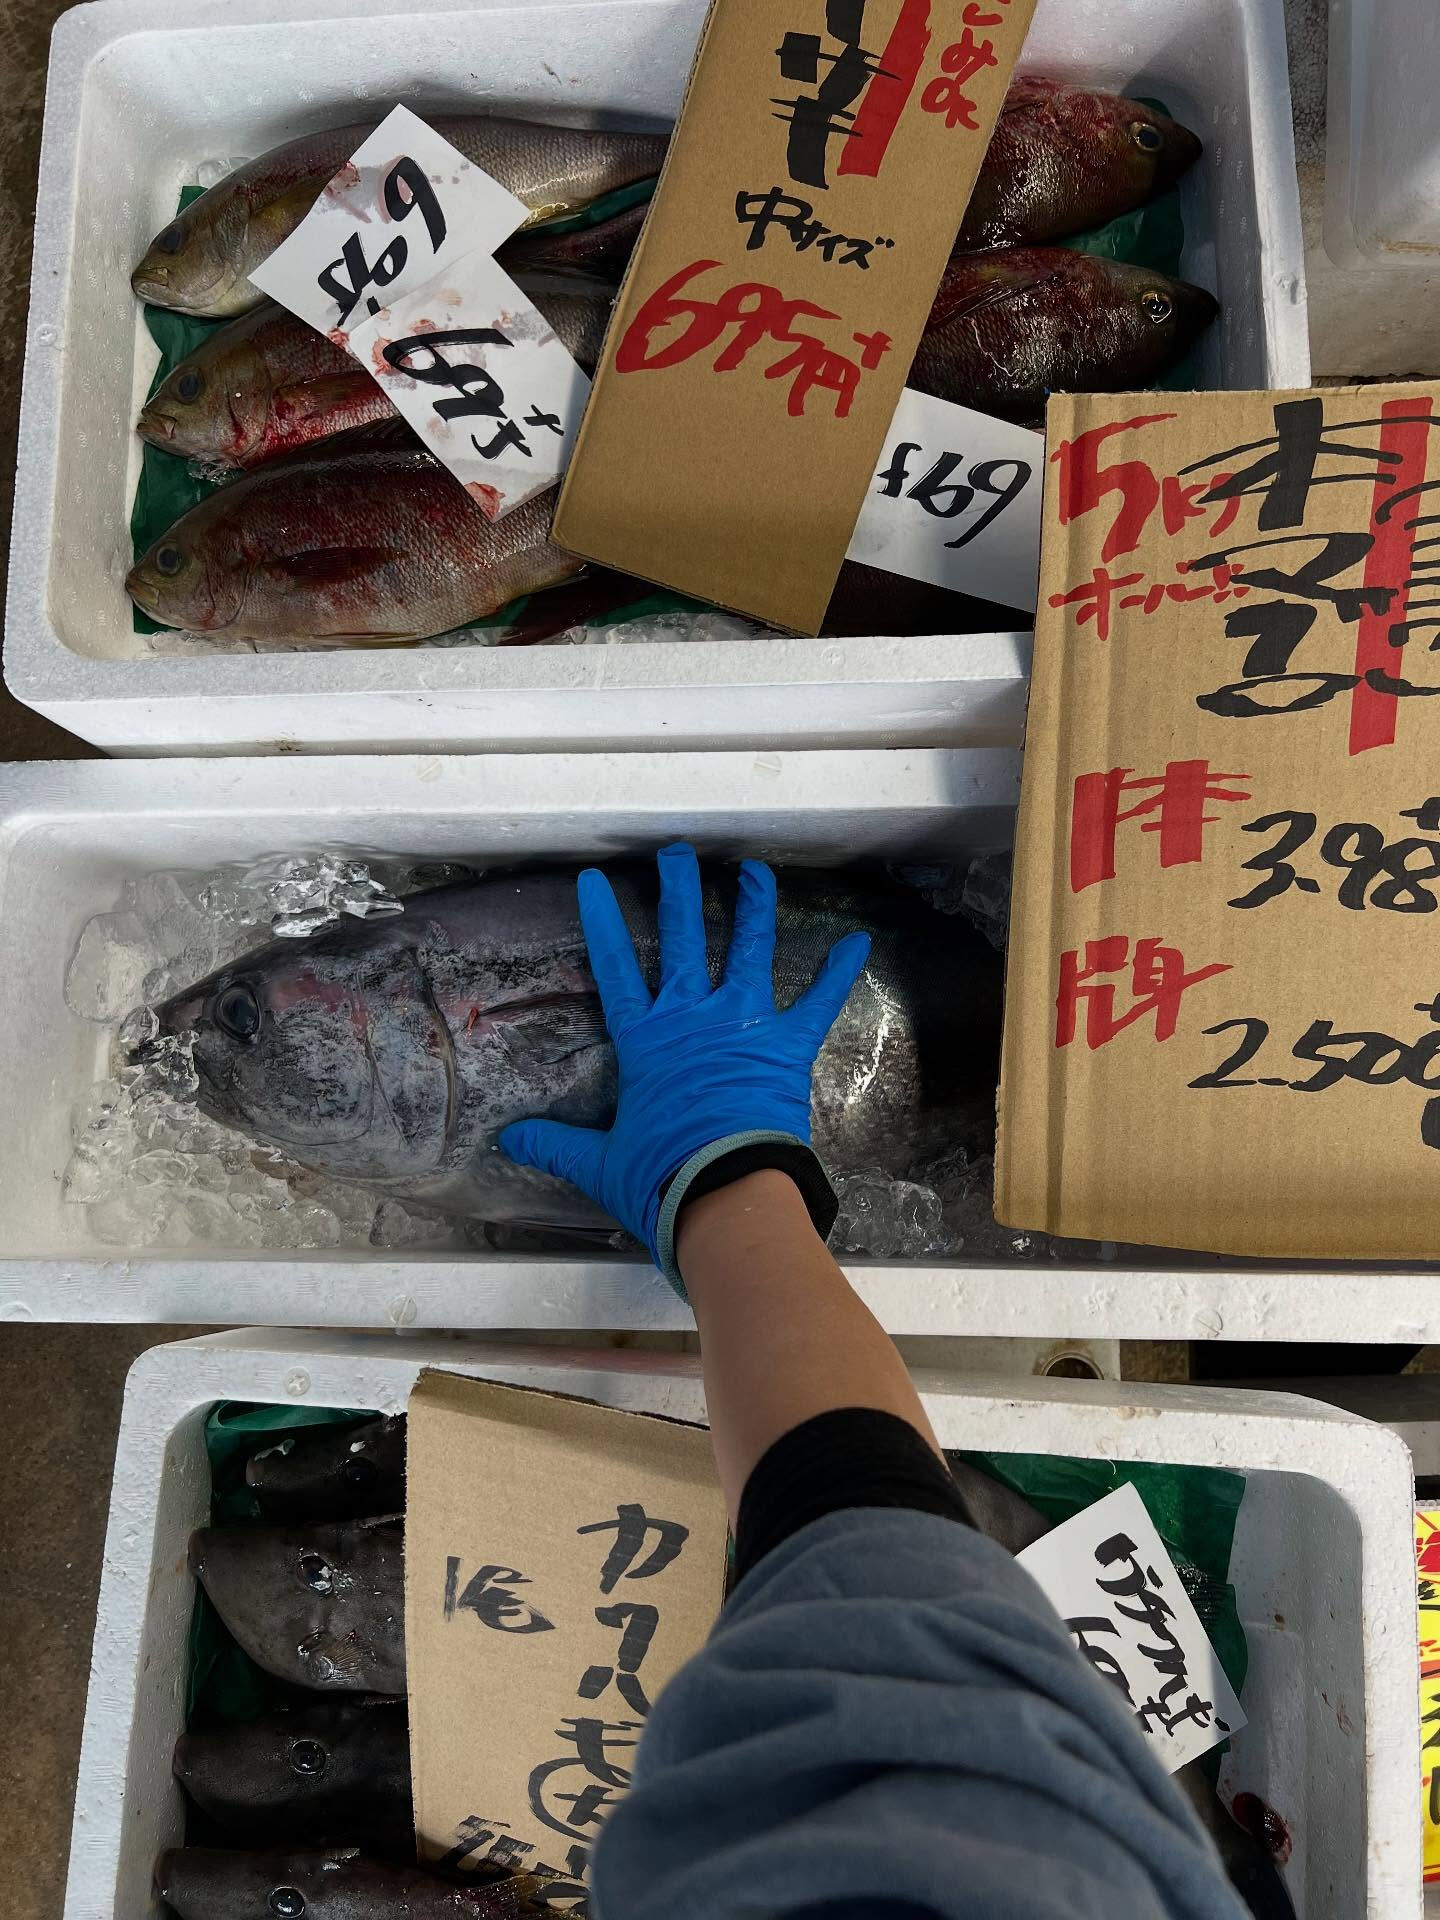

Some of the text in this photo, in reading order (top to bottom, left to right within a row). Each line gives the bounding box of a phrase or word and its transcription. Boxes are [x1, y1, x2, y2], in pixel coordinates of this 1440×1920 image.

[318, 156, 447, 327] 695
[736, 186, 895, 270] 中サイズ
[1055, 936, 1235, 1051] 片身
